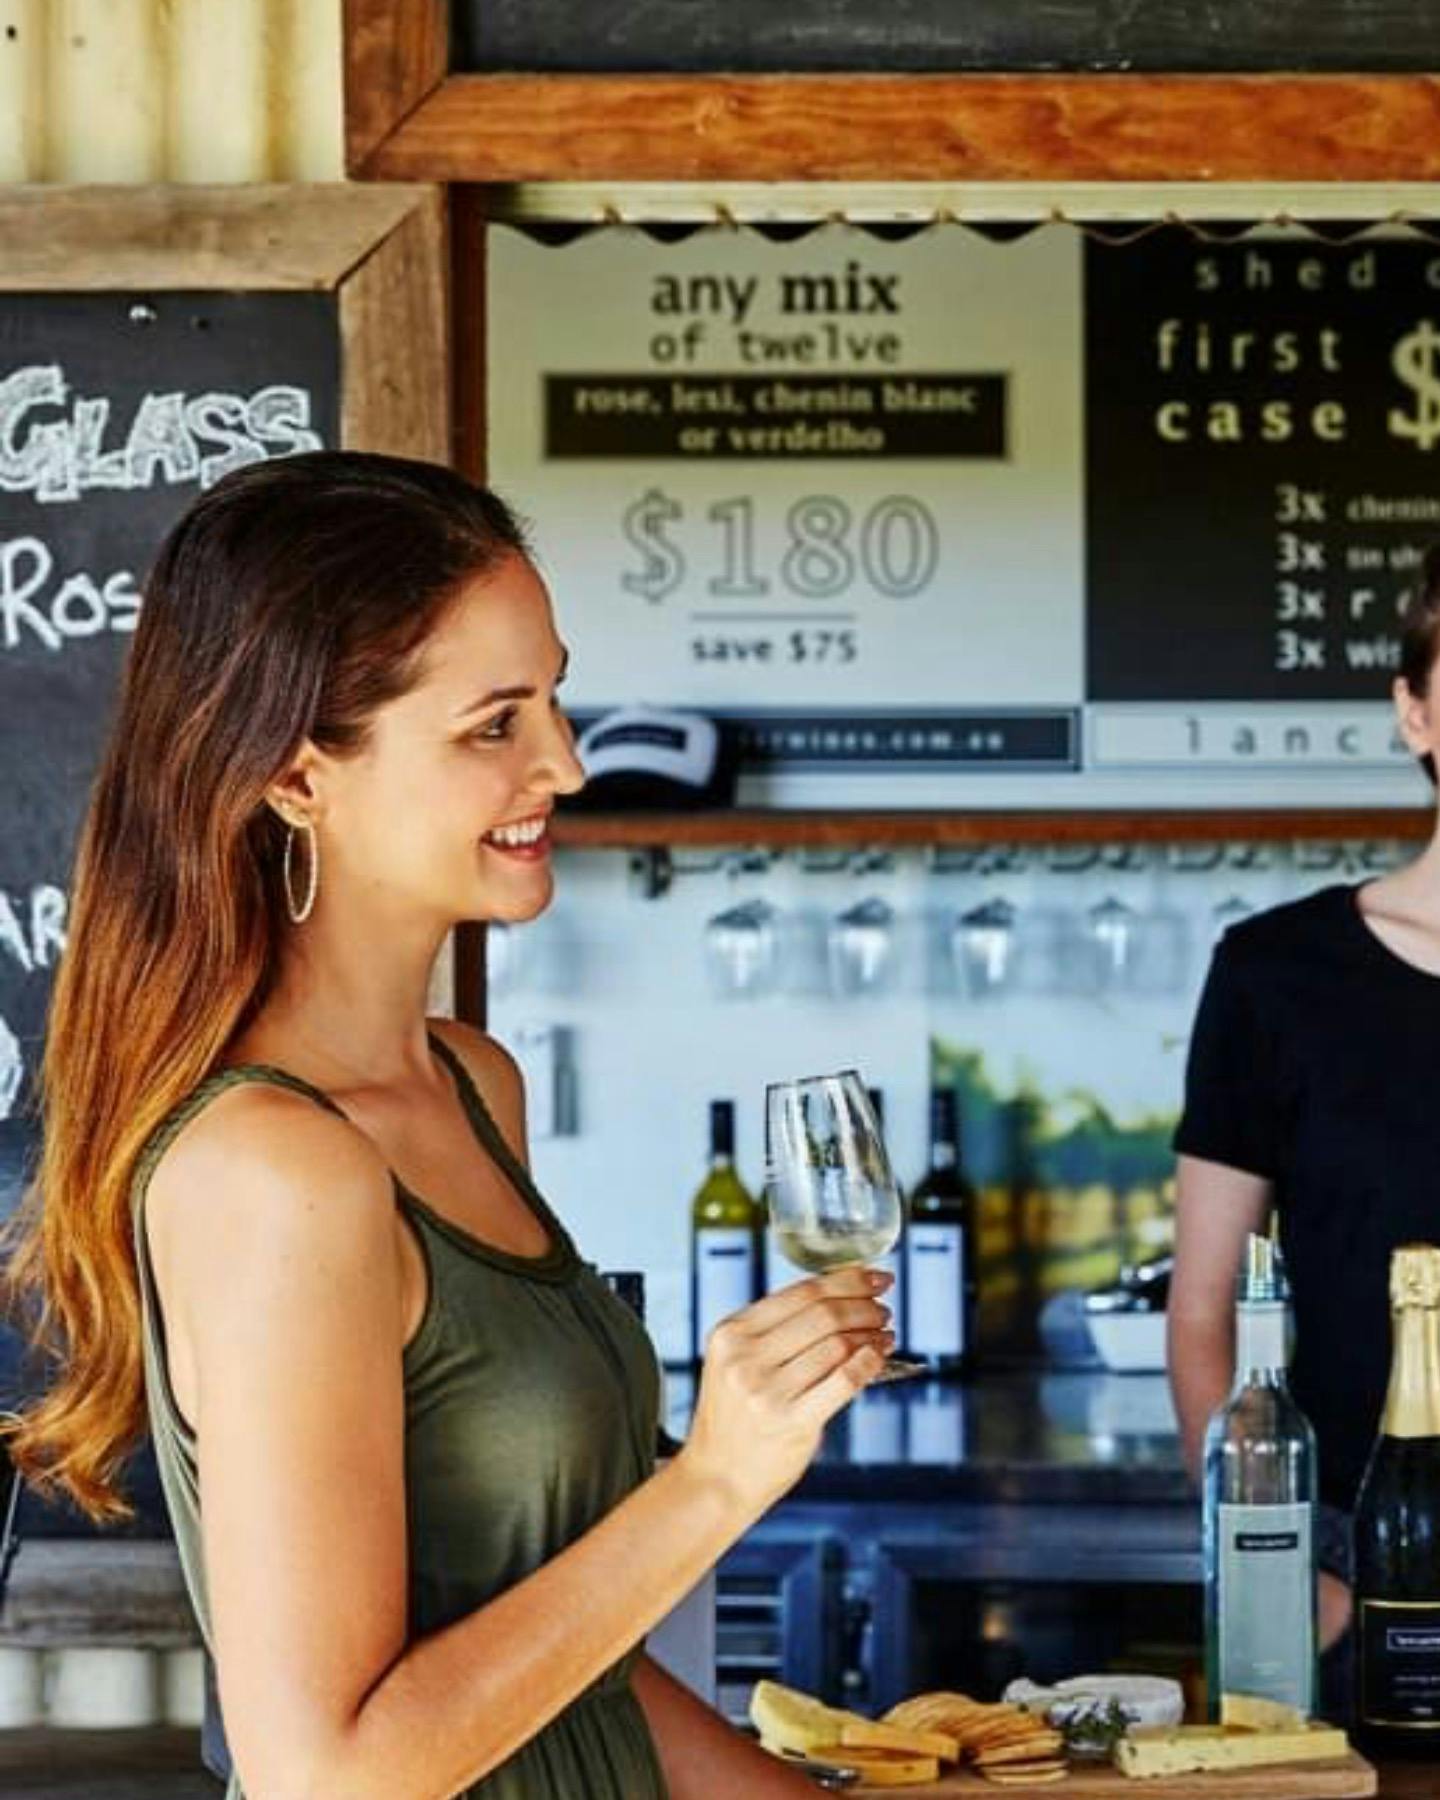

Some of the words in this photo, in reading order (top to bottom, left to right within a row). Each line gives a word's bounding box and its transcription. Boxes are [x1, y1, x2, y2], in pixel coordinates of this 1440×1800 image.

[1197, 251, 1375, 289] shed
[651, 274, 758, 325] any
[781, 260, 899, 315] mix
[650, 321, 706, 362] of
[738, 321, 900, 363] twelve
[1158, 318, 1342, 371] first
[753, 383, 874, 412] chenin
[882, 382, 980, 412] blanc
[0, 364, 323, 503] GLASS
[678, 426, 720, 451] or
[728, 421, 886, 451] verdelho
[1155, 400, 1348, 441] case
[1275, 483, 1326, 523] 3x
[620, 487, 940, 605] $180
[1276, 532, 1326, 572] 3x
[0, 536, 142, 650] Ros
[1276, 581, 1326, 621] 3x
[692, 638, 773, 663] save
[788, 629, 857, 663] $75
[1275, 630, 1326, 670] 3x
[1185, 715, 1409, 754] lanc
